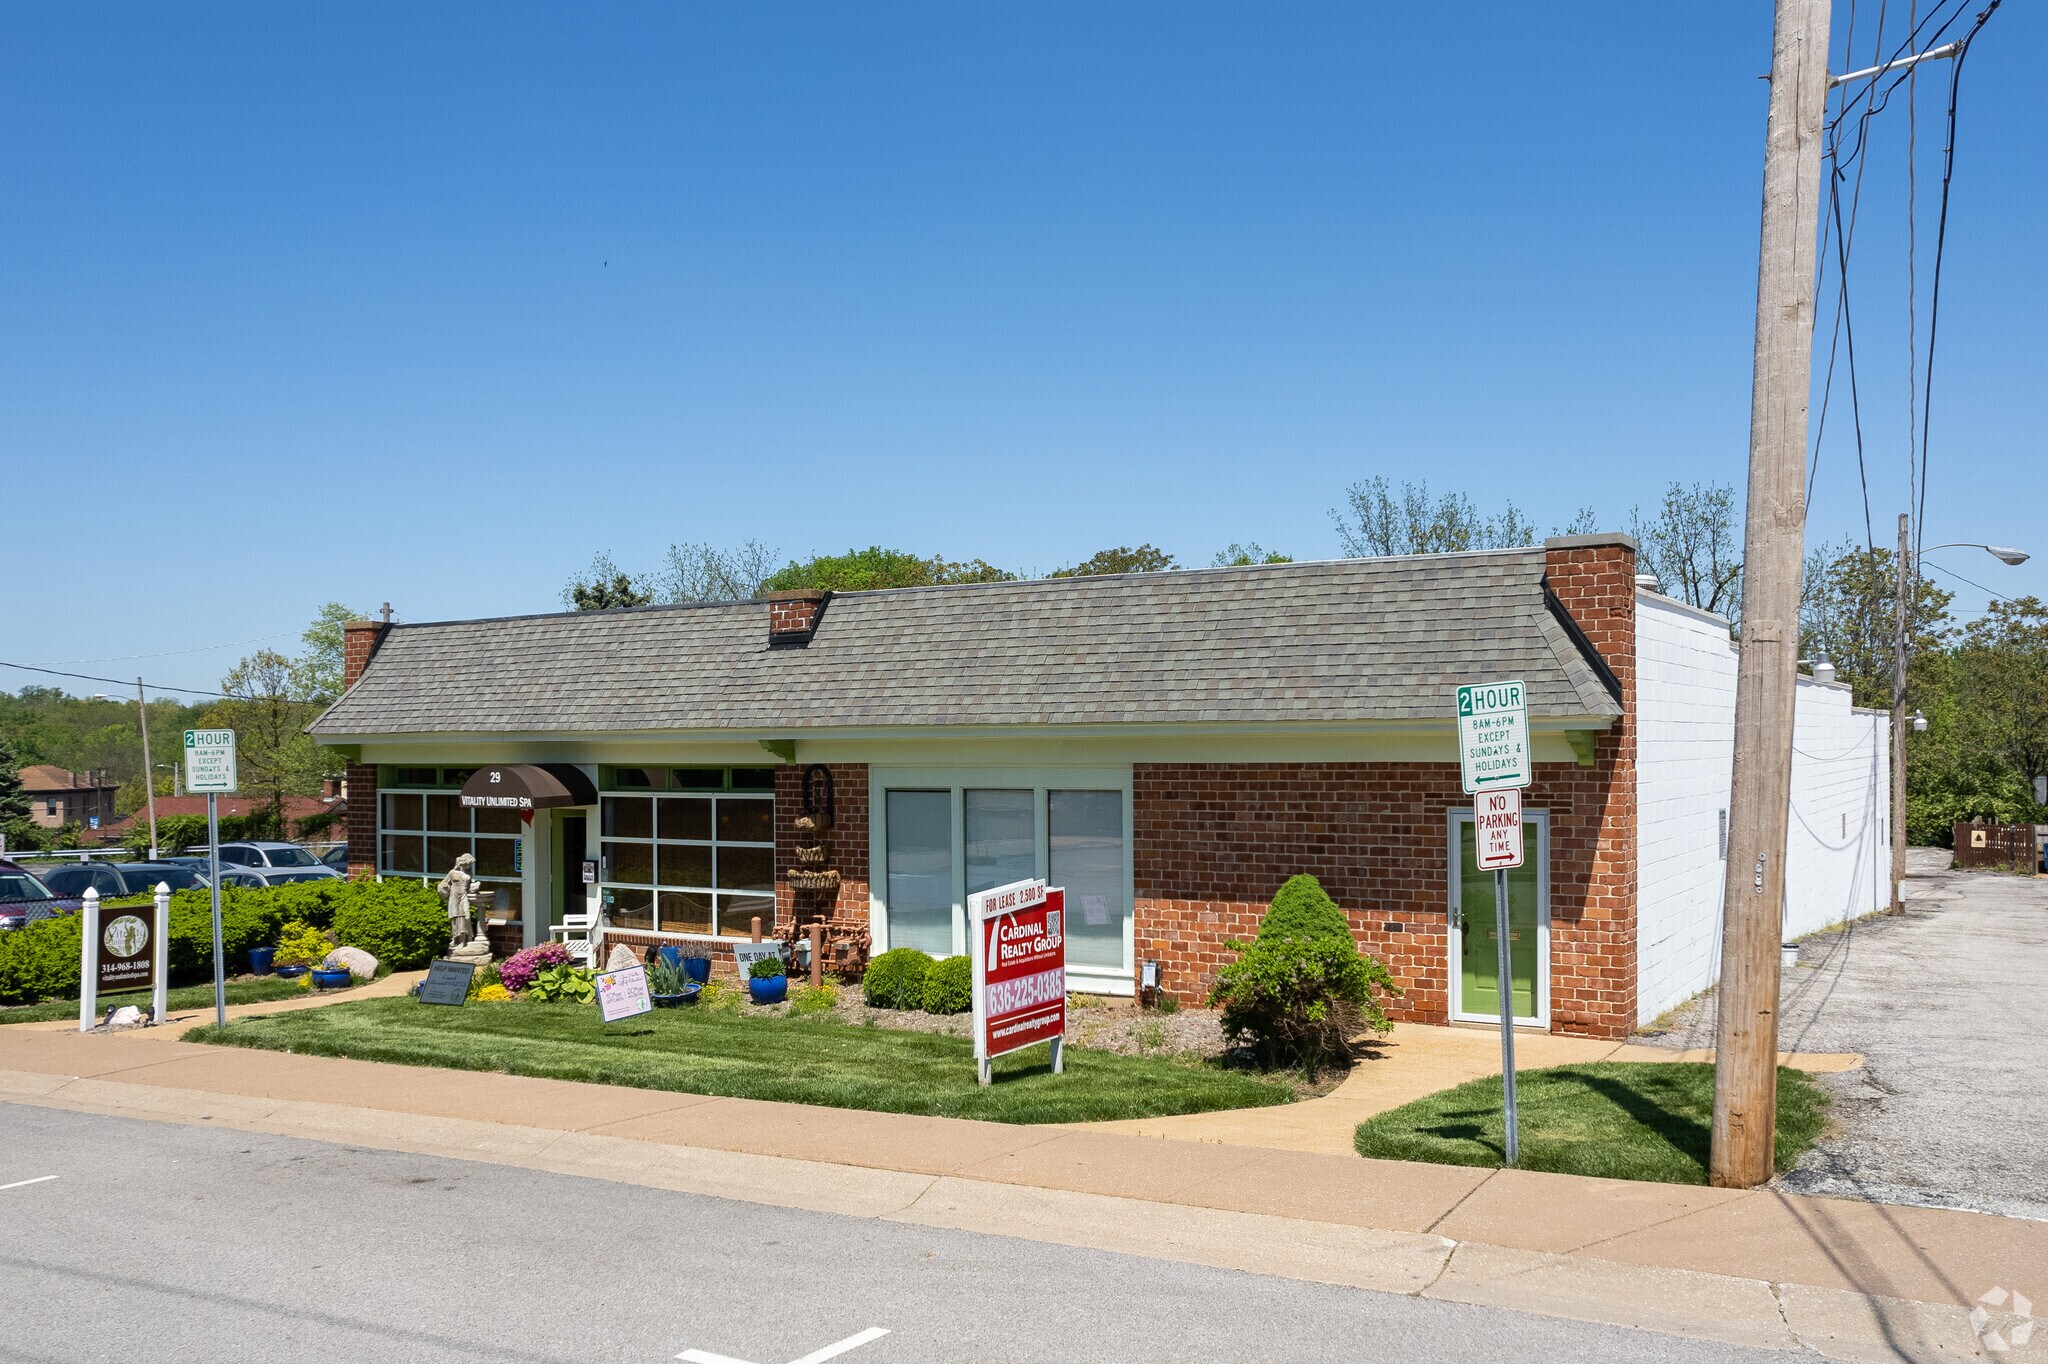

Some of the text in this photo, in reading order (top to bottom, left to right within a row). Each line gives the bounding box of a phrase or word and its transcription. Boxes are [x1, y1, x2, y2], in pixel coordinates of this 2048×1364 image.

[1460, 687, 1520, 712] 2 HOUR
[1473, 716, 1515, 730] 8AM-6PM
[186, 733, 230, 746] 2 HOUR
[1478, 730, 1510, 743] EXCEPT
[1470, 743, 1521, 759] SUNDAYS &
[1475, 757, 1518, 772] HOLIDAYS
[490, 771, 501, 783] 29
[1489, 796, 1506, 811] NO
[1479, 812, 1518, 830] PARKING
[1491, 829, 1508, 840] ANY
[1489, 841, 1510, 852] TIME
[986, 885, 1044, 913] FOR LEASE 2,500 SF
[1000, 922, 1044, 942] CARDINAL
[1001, 935, 1062, 960] REALTY GROUP
[739, 952, 753, 962] ONE
[753, 951, 766, 961] DAY
[101, 960, 150, 974] 314-968-1808
[448, 966, 470, 974] WANTED
[989, 970, 1062, 1015] 636-225-0385
[992, 1012, 1060, 1039] www.cardinalrealtygroup.com
